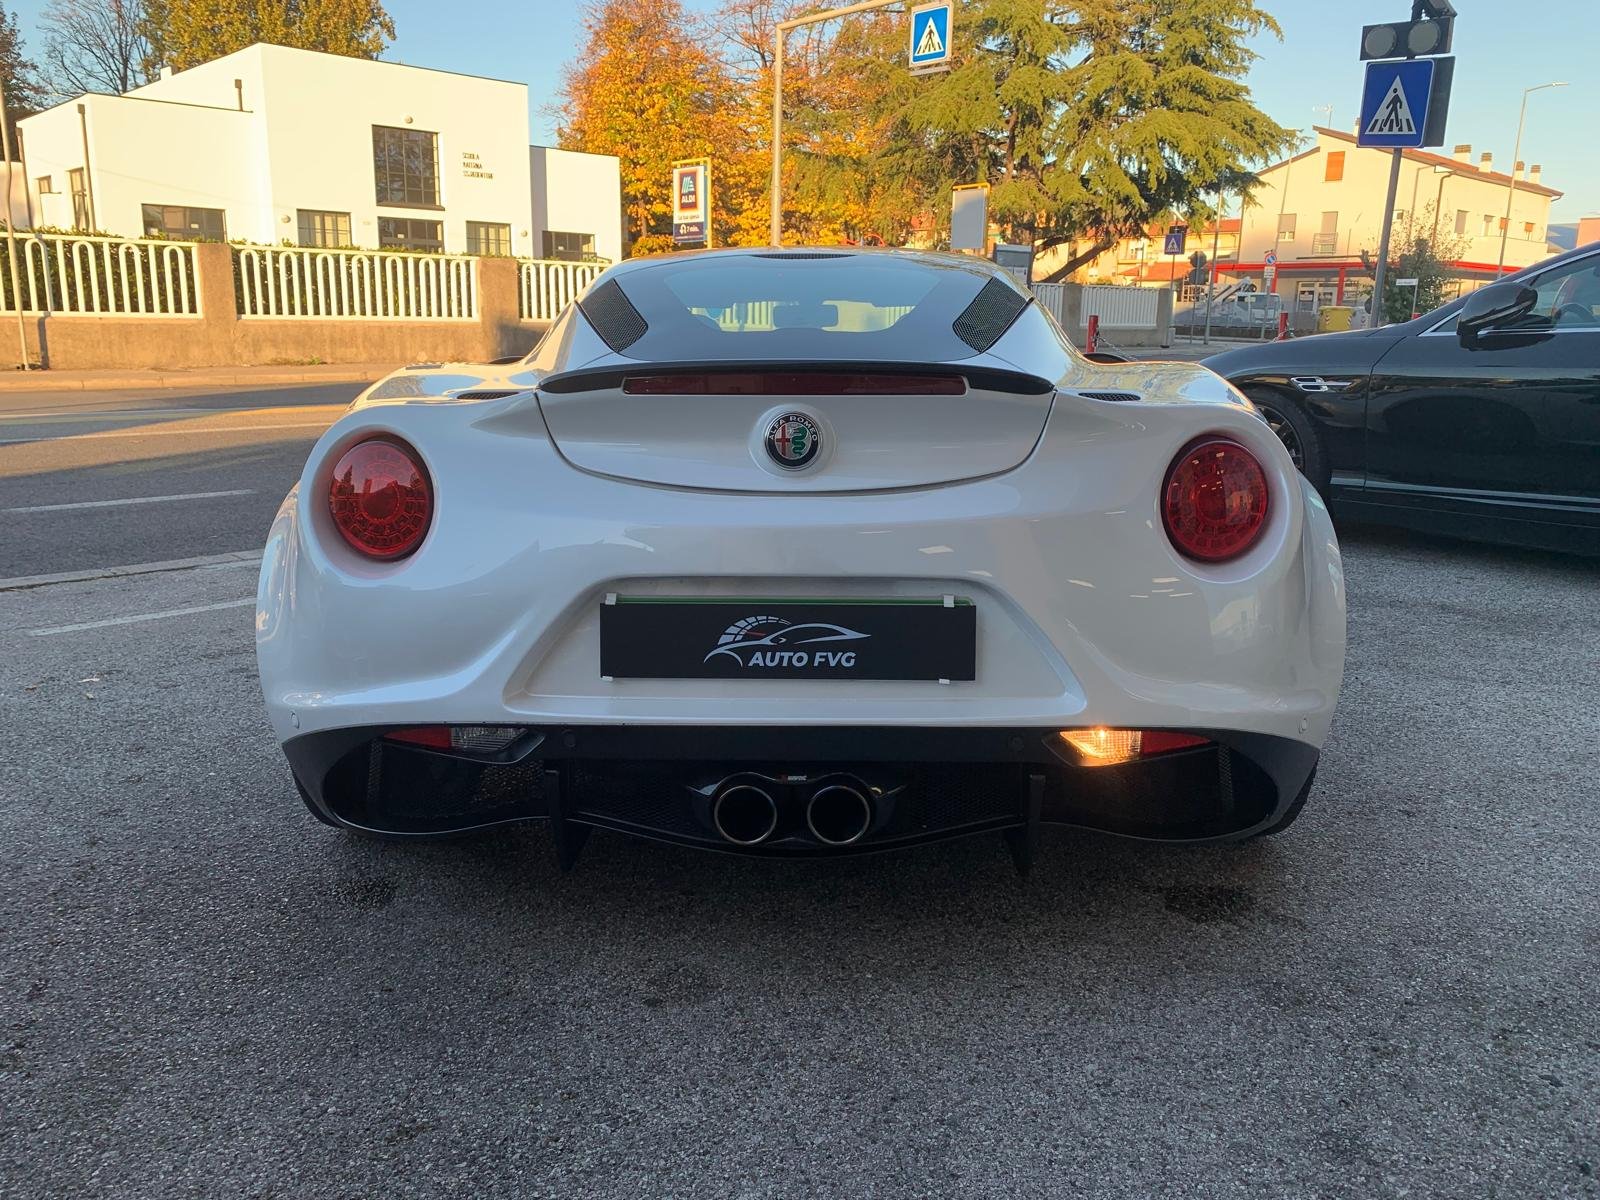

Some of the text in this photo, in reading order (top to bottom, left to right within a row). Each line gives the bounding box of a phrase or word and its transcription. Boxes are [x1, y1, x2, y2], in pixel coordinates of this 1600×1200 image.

[681, 194, 696, 204] ALDI
[768, 415, 818, 441] ALFA ROMEO
[747, 651, 857, 667] AUTO FVG
